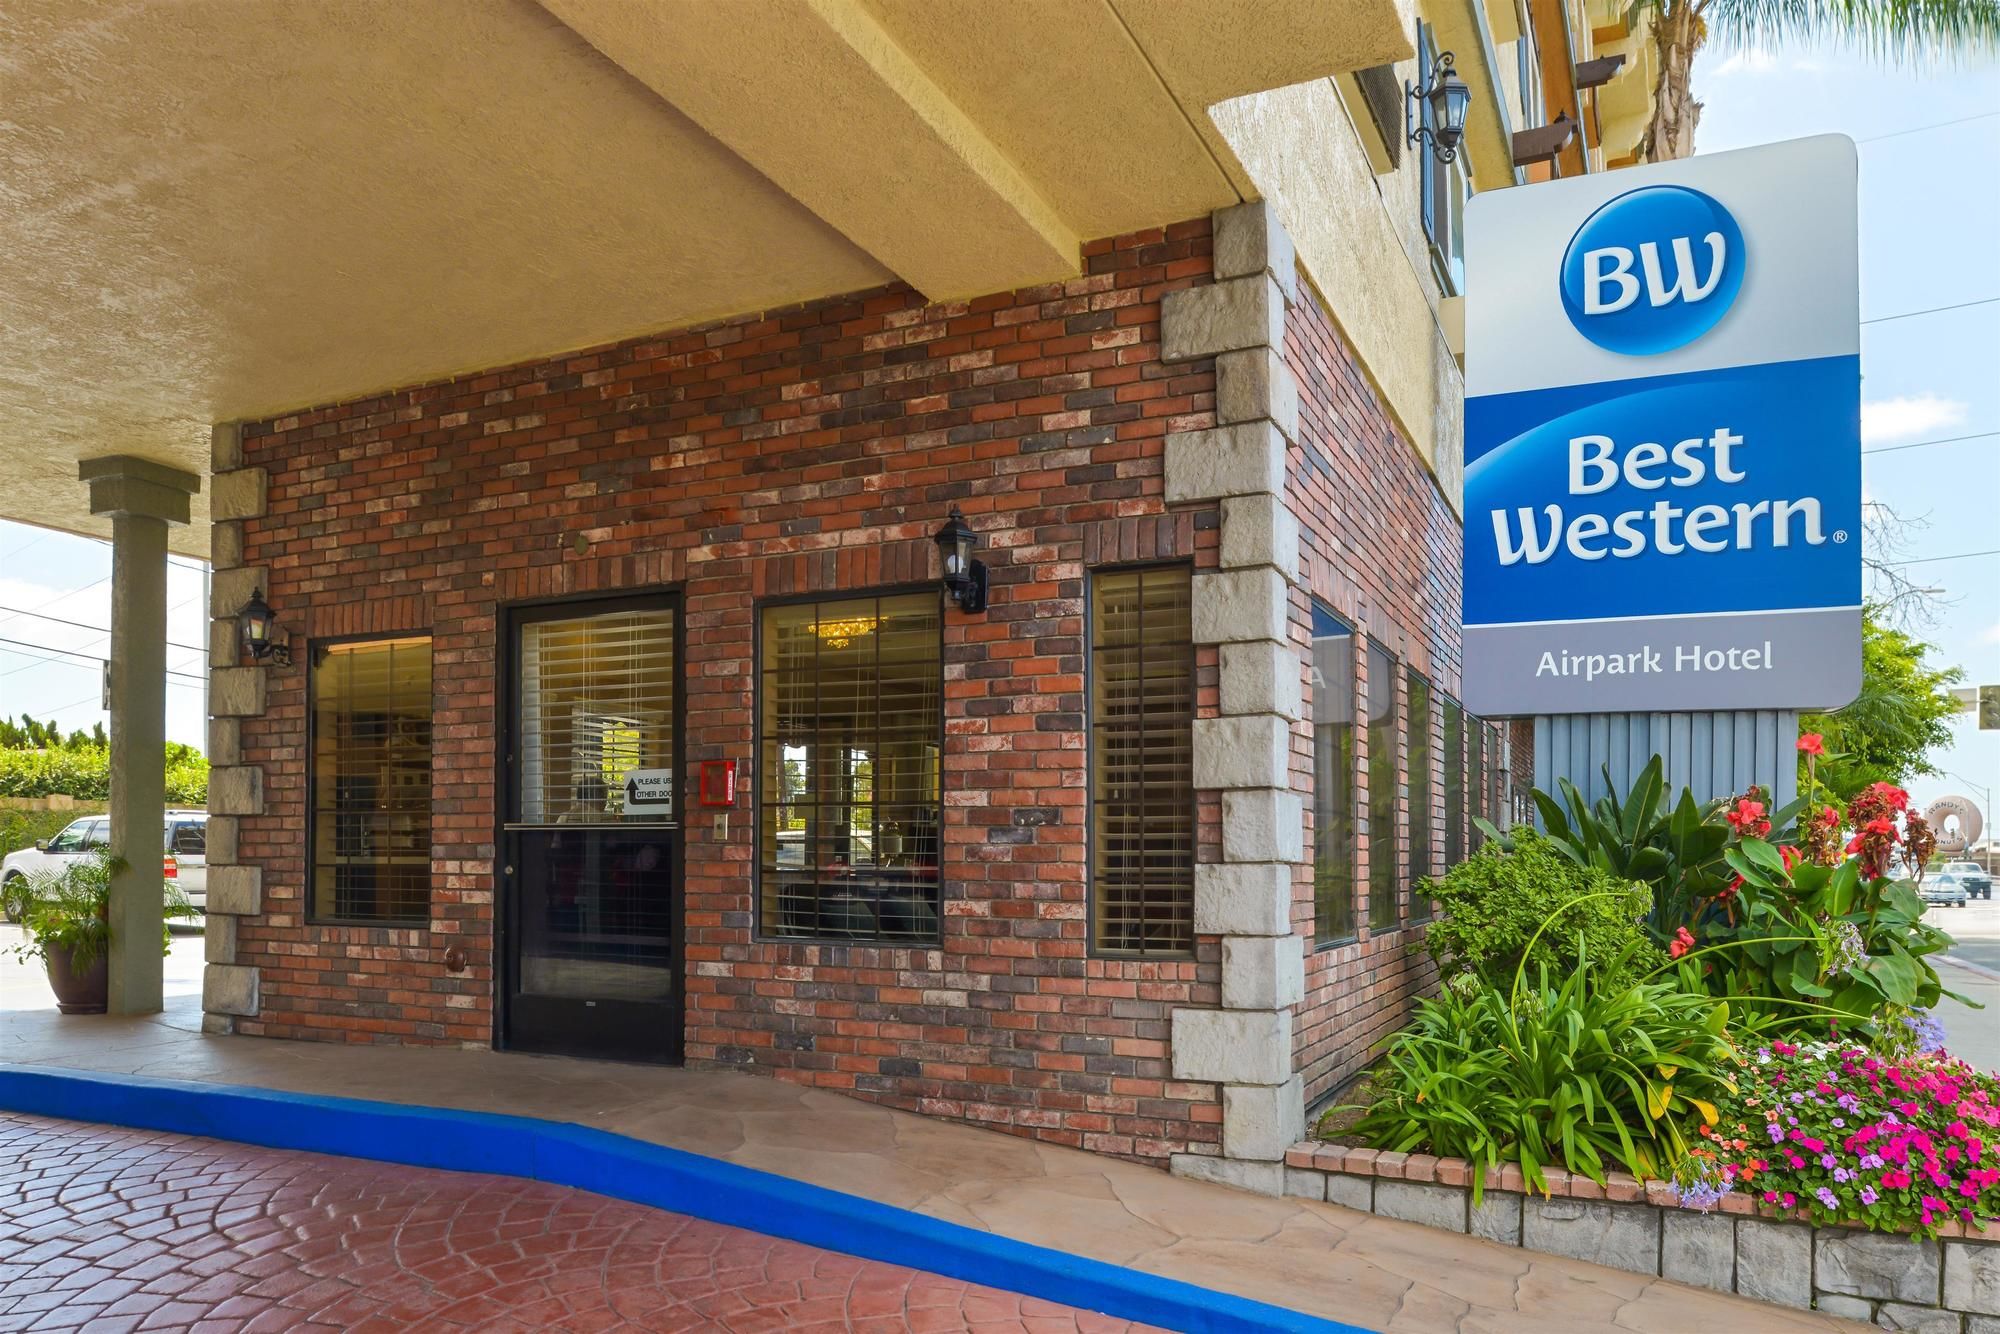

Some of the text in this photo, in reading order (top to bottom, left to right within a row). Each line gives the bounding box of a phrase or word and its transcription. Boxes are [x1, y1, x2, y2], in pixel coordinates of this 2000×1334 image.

[1582, 231, 1727, 315] BW
[1567, 427, 1747, 496] Best
[1535, 642, 1774, 681] Airpark Hotel
